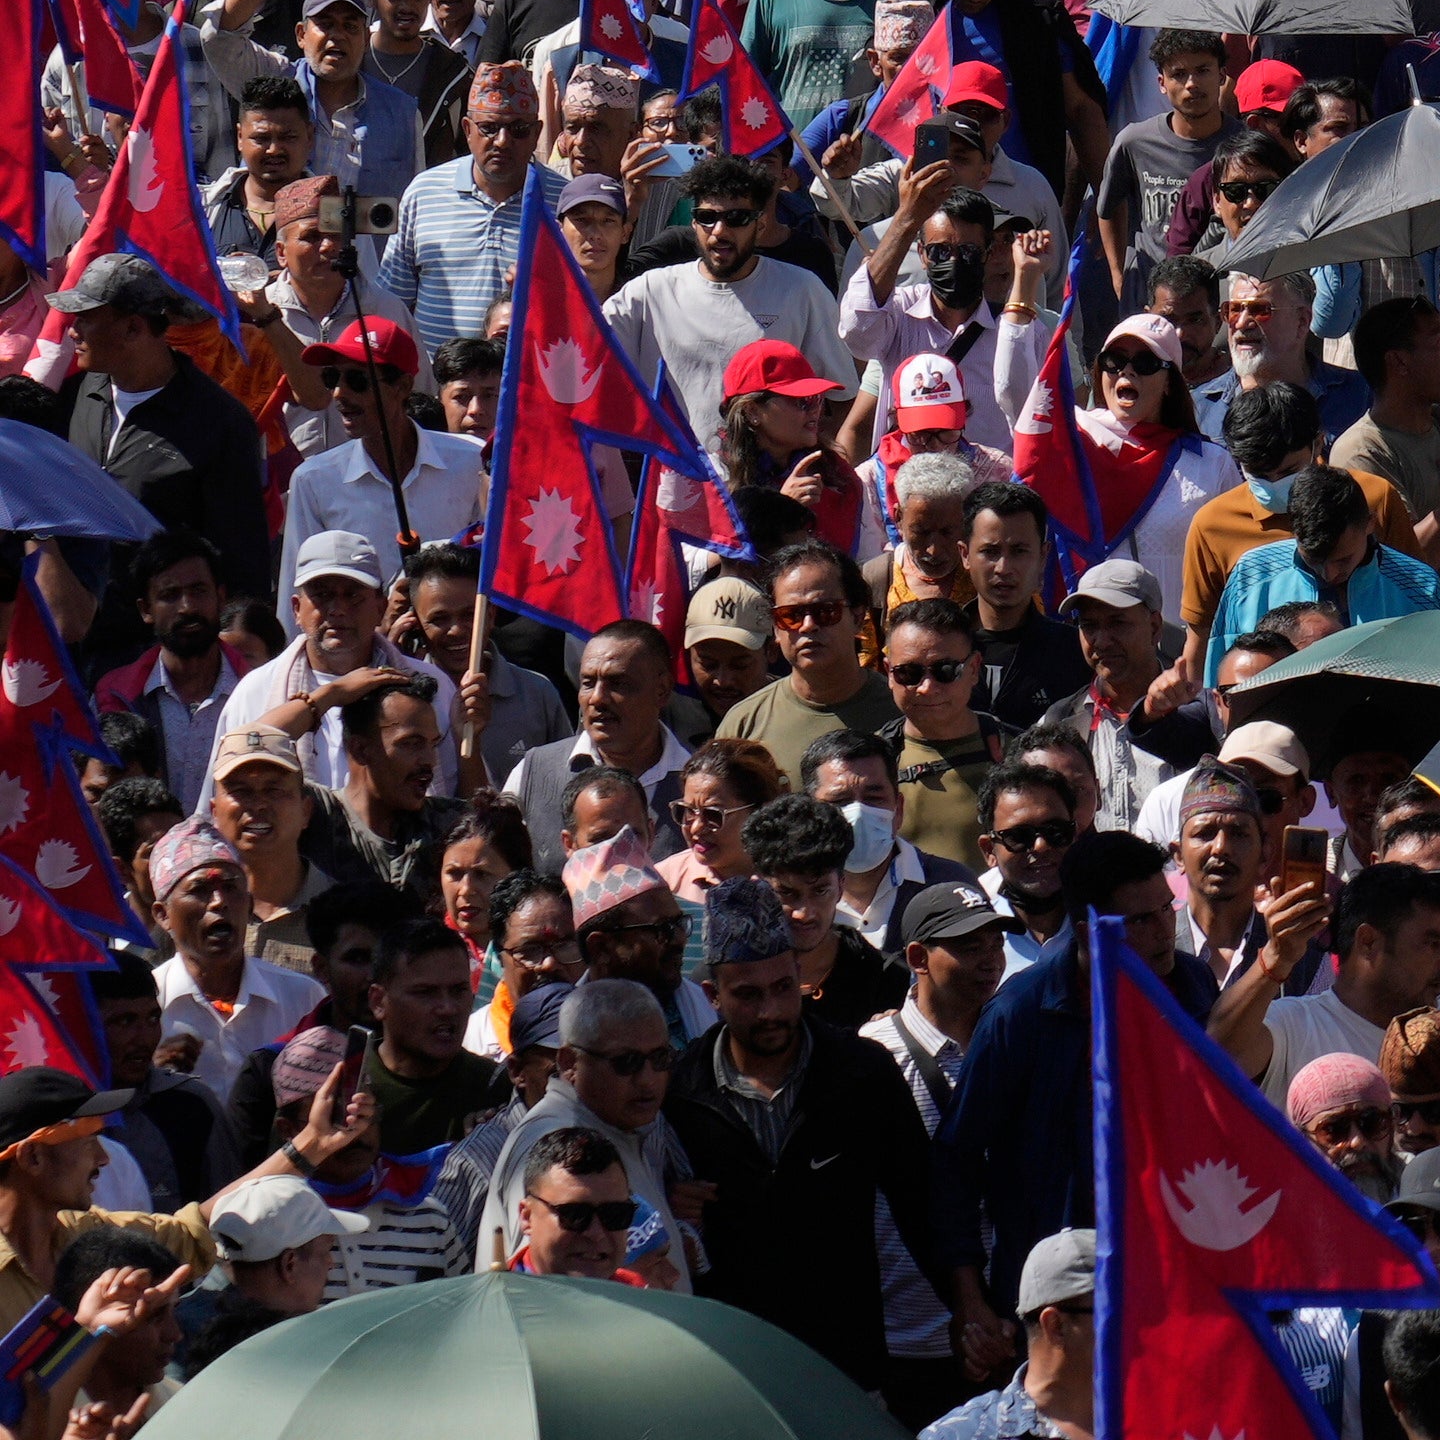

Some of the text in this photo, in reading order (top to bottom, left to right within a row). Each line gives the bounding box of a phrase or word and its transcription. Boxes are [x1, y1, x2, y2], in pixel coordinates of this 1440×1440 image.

[1143, 171, 1165, 186] People
[714, 595, 736, 620] NY
[952, 886, 988, 909] LA
